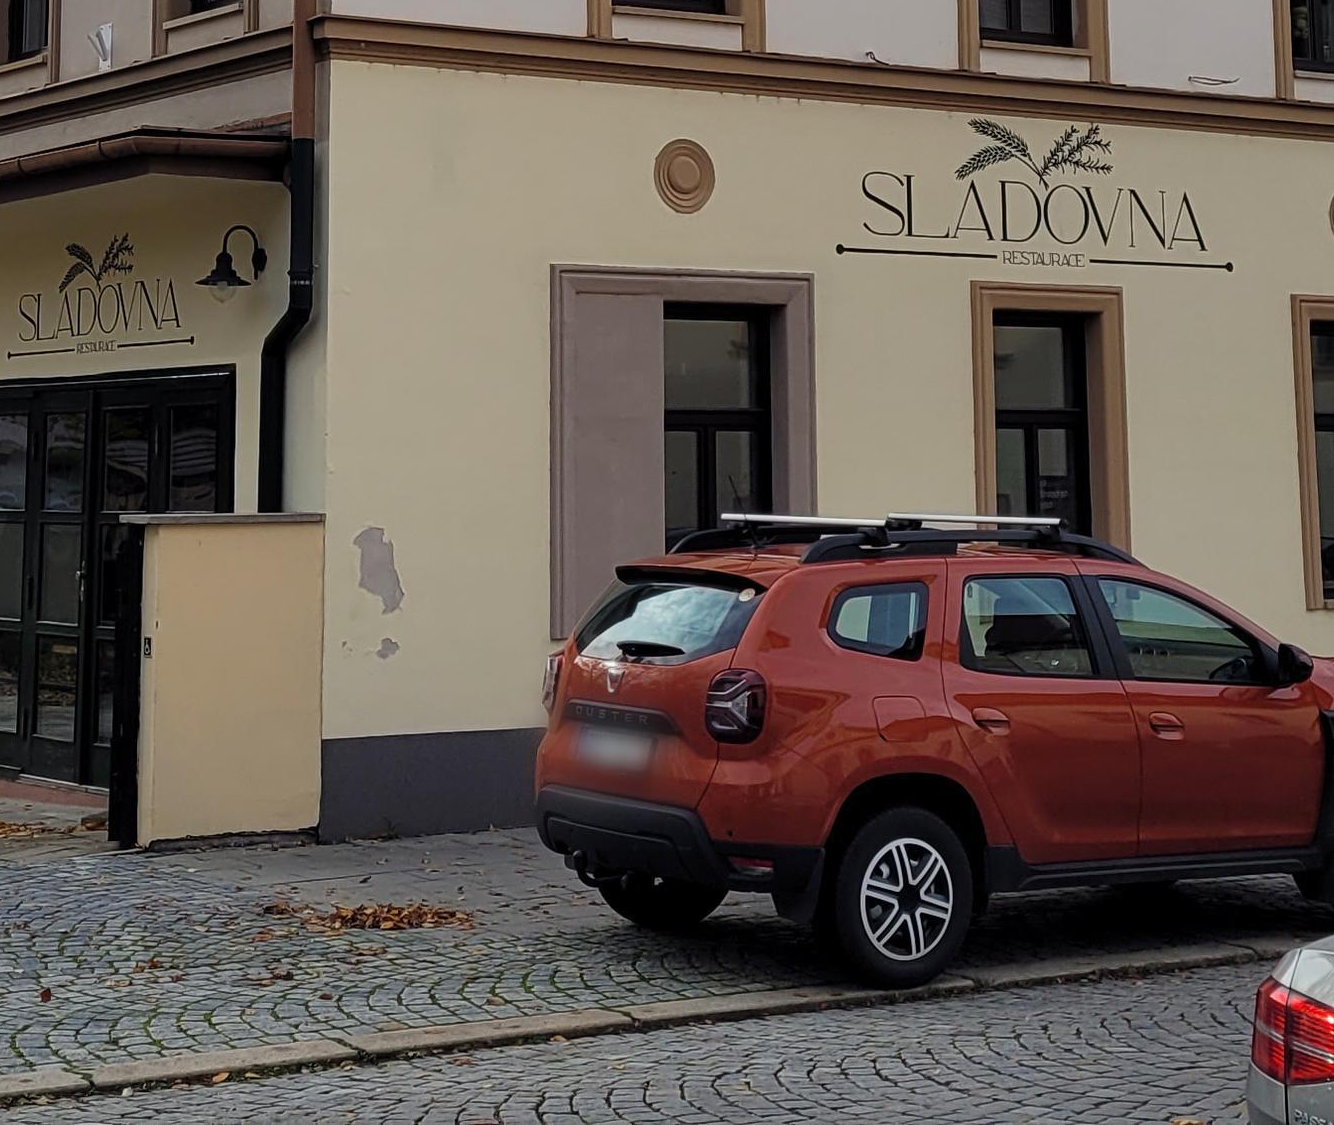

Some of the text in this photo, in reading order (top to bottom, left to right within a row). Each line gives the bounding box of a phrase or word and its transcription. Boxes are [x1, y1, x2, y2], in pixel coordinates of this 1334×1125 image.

[861, 170, 1209, 252] SLADOVNA
[1001, 250, 1086, 268] RESTAURACE
[18, 277, 182, 342] SLADOVNA
[76, 340, 116, 354] RESTAURACE
[576, 706, 647, 723] DUSTER
